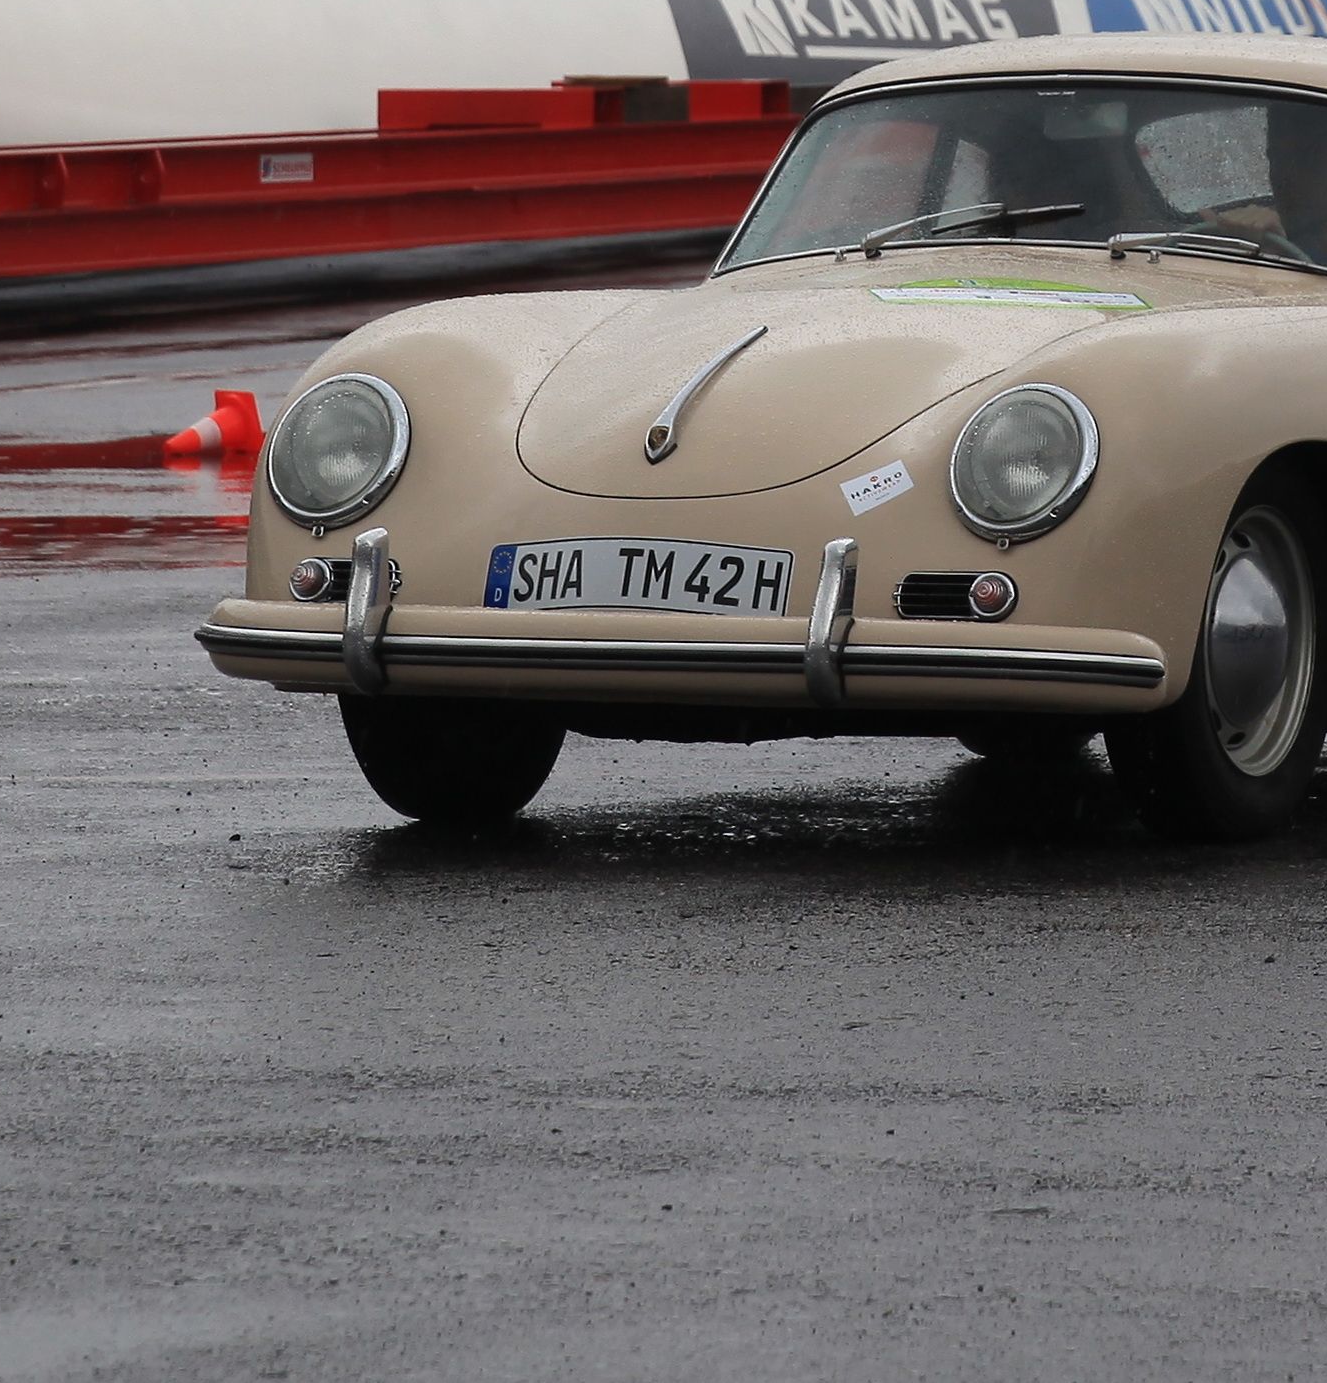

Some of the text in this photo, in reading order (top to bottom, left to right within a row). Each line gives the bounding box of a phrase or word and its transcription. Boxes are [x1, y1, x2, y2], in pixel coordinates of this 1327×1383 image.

[851, 471, 902, 500] HAKRO
[513, 549, 583, 602] SHA
[494, 587, 502, 602] D
